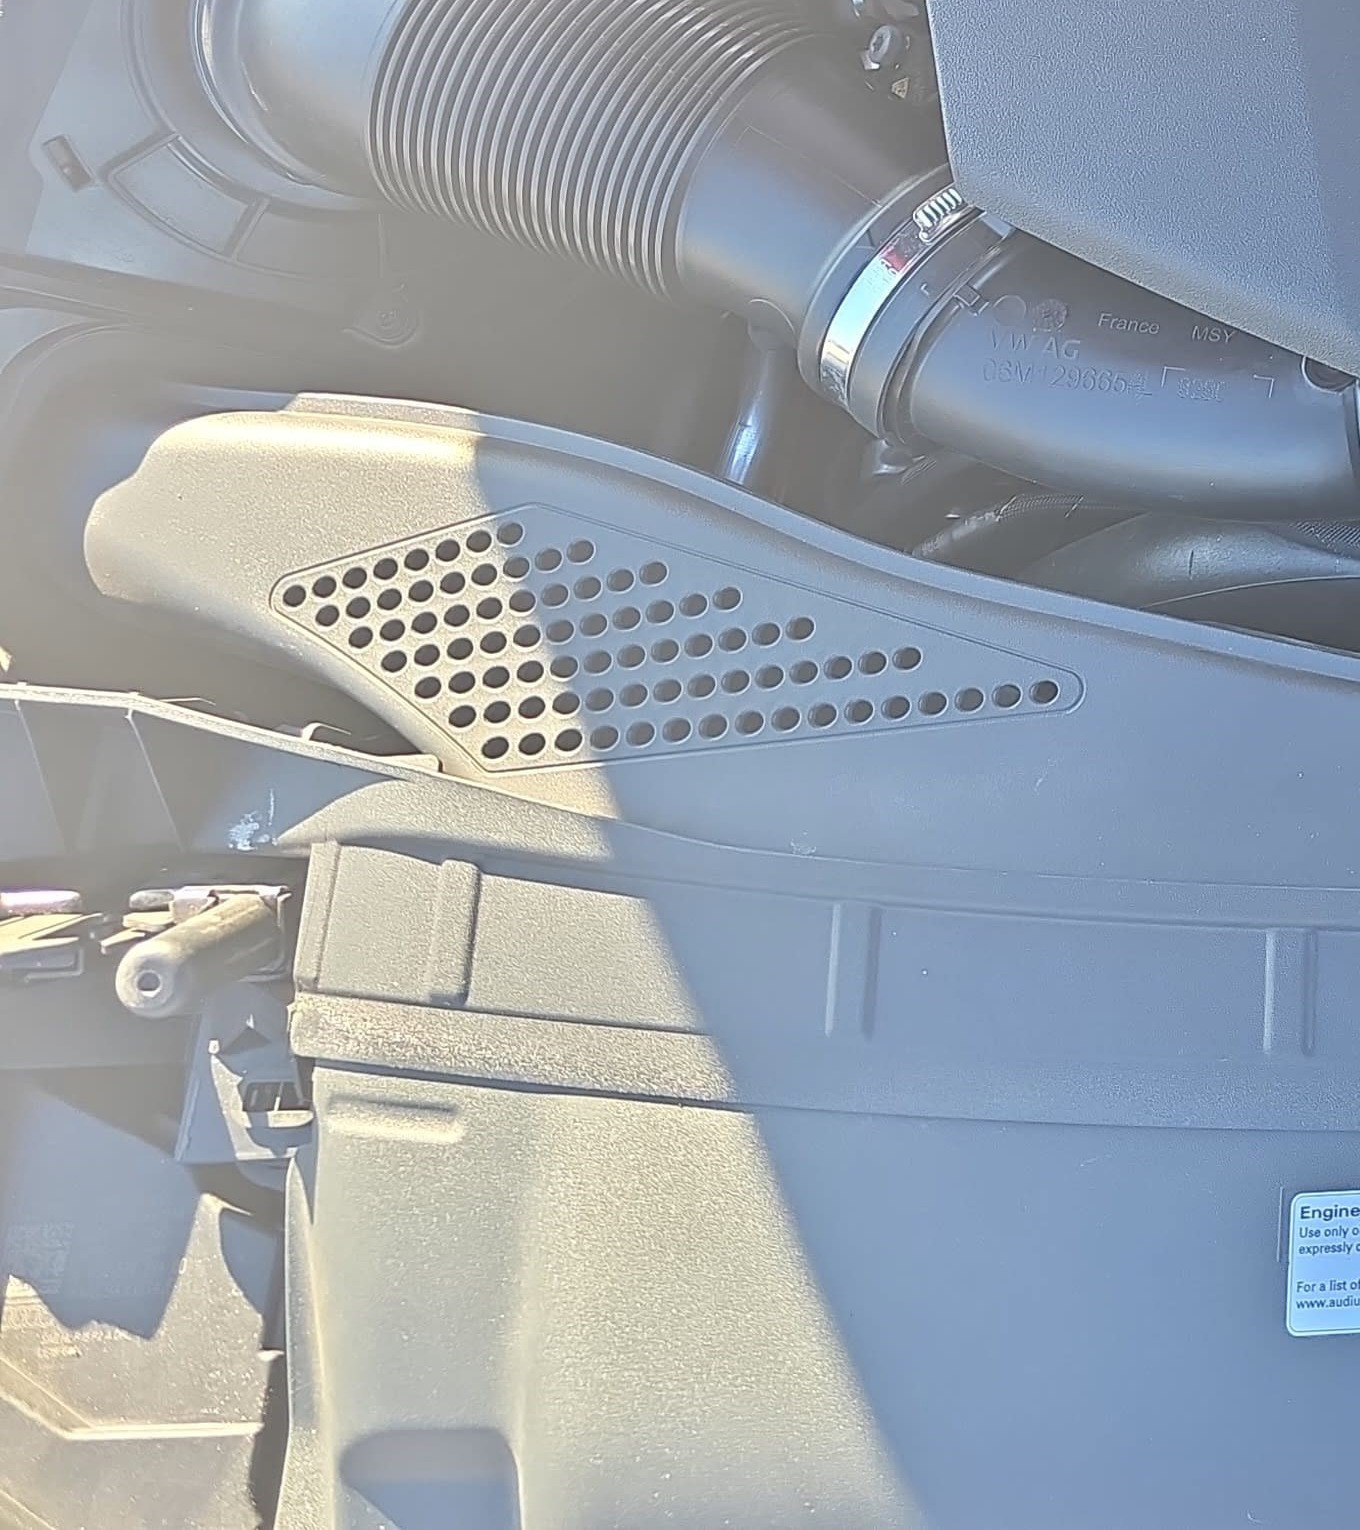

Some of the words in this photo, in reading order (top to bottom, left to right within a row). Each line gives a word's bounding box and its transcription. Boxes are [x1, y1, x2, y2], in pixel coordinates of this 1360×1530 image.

[1097, 312, 1161, 336] France
[1191, 324, 1238, 345] MSY
[1041, 337, 1083, 361] AG
[1299, 1203, 1360, 1221] Engine
[1298, 1226, 1321, 1238] Use
[1323, 1224, 1349, 1239] only
[1298, 1240, 1353, 1256] expressly
[1296, 1280, 1316, 1293] For
[1318, 1282, 1326, 1292] a
[1328, 1278, 1347, 1291] list
